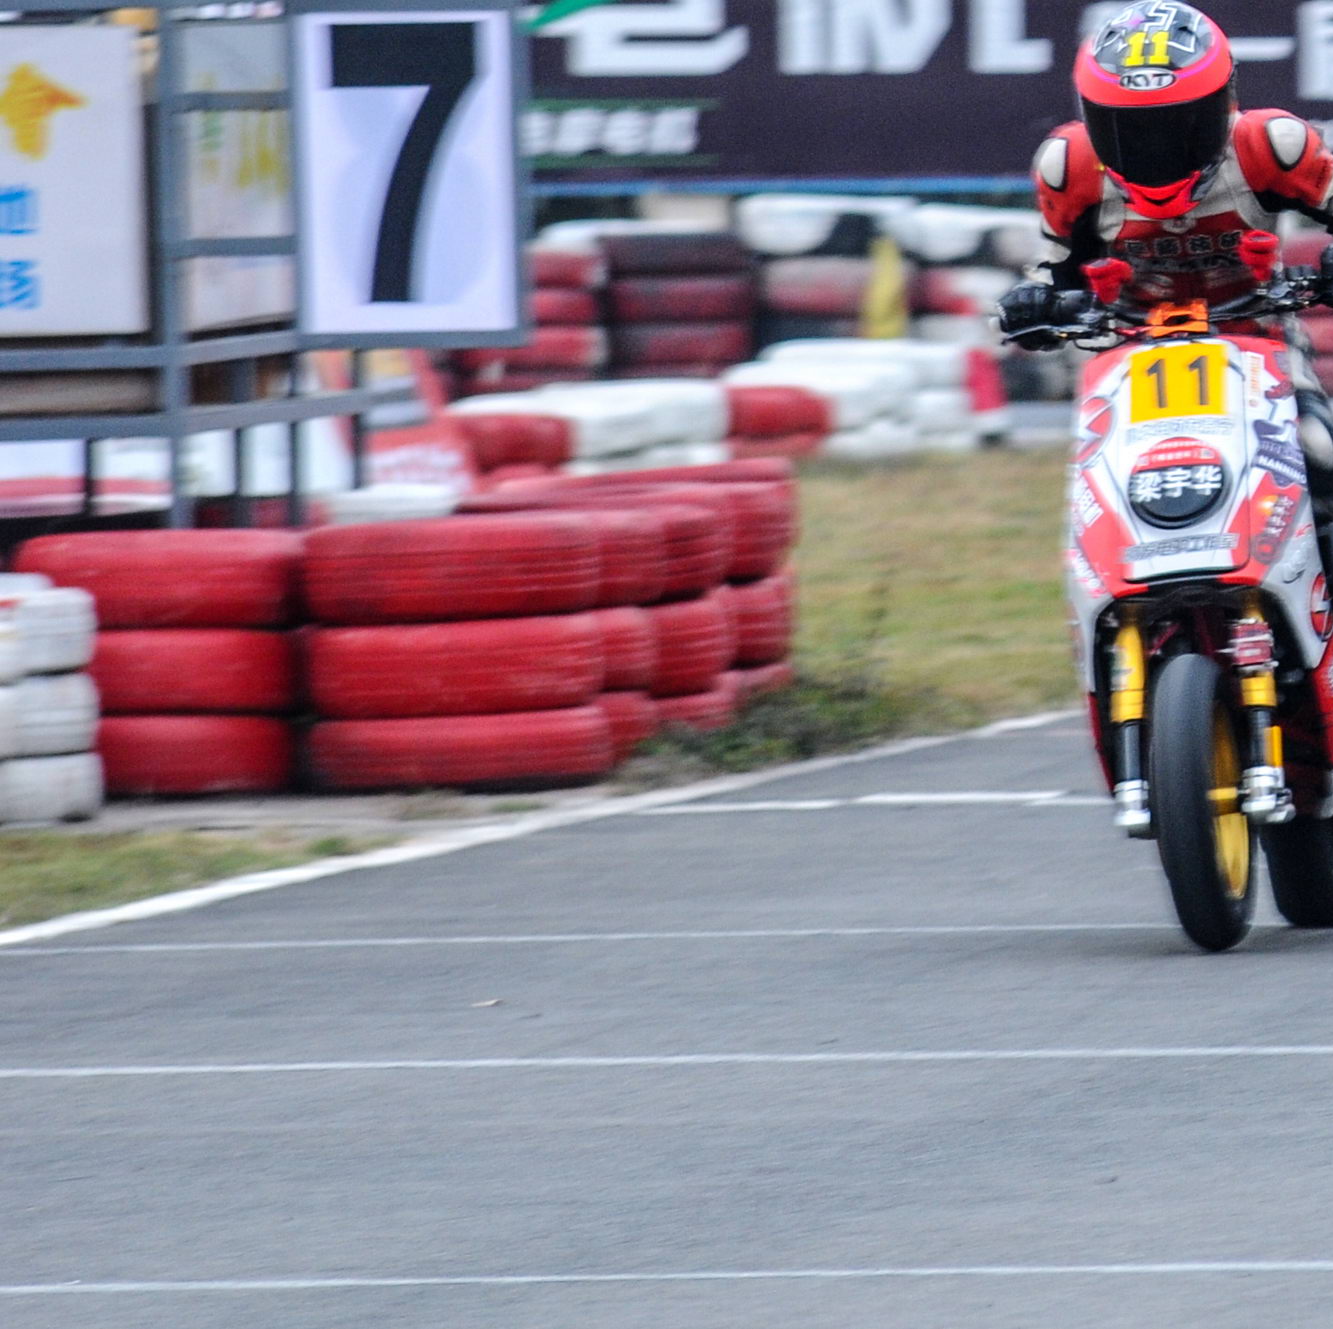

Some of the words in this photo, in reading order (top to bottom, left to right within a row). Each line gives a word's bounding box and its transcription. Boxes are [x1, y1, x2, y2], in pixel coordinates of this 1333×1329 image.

[1124, 31, 1170, 68] 11
[1121, 74, 1171, 88] KYT
[332, 22, 476, 303] 7
[1146, 355, 1209, 409] 11
